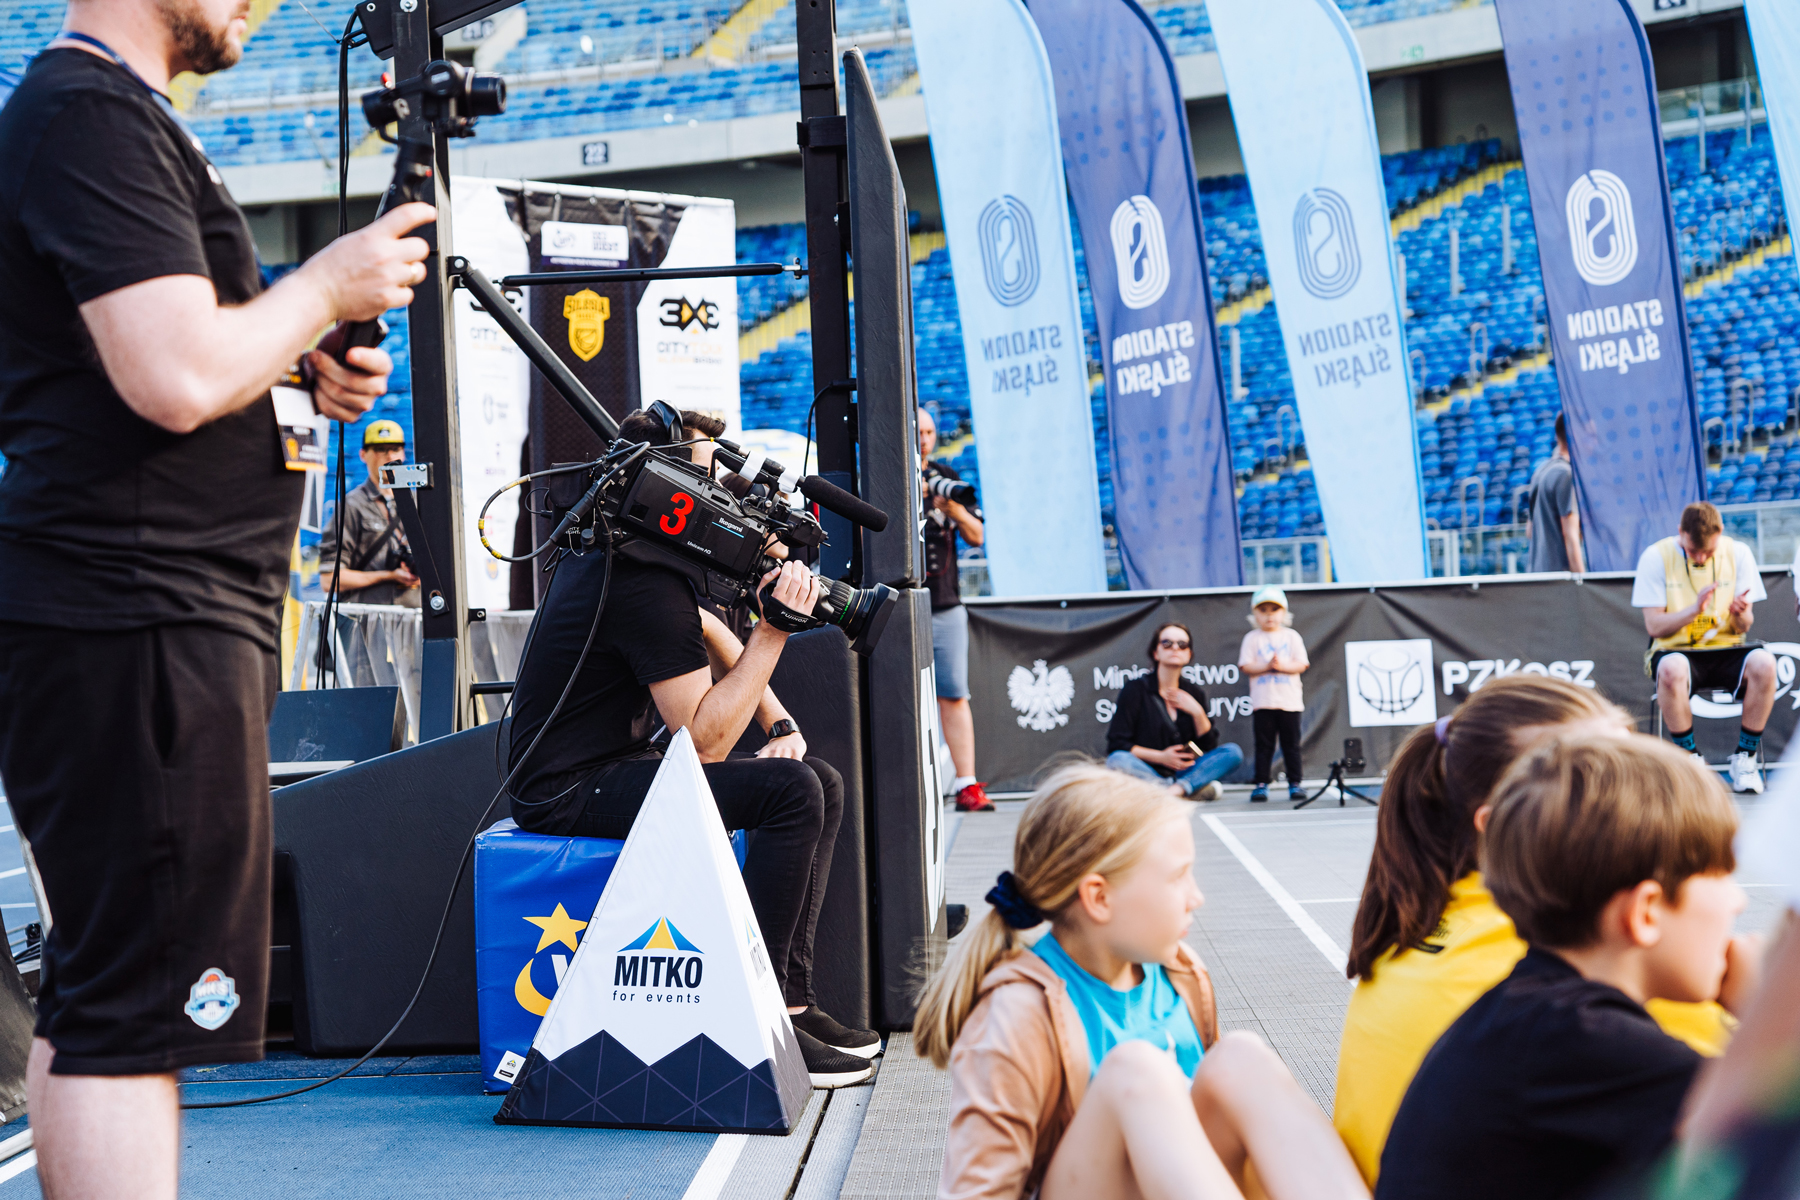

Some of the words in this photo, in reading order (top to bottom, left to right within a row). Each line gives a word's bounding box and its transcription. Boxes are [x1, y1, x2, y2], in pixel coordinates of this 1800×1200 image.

[659, 492, 695, 535] 3
[718, 517, 744, 533] Ikegami
[780, 610, 809, 624] FUJINON
[613, 955, 704, 988] MITKO
[612, 990, 635, 1001] for
[646, 993, 700, 1003] events
